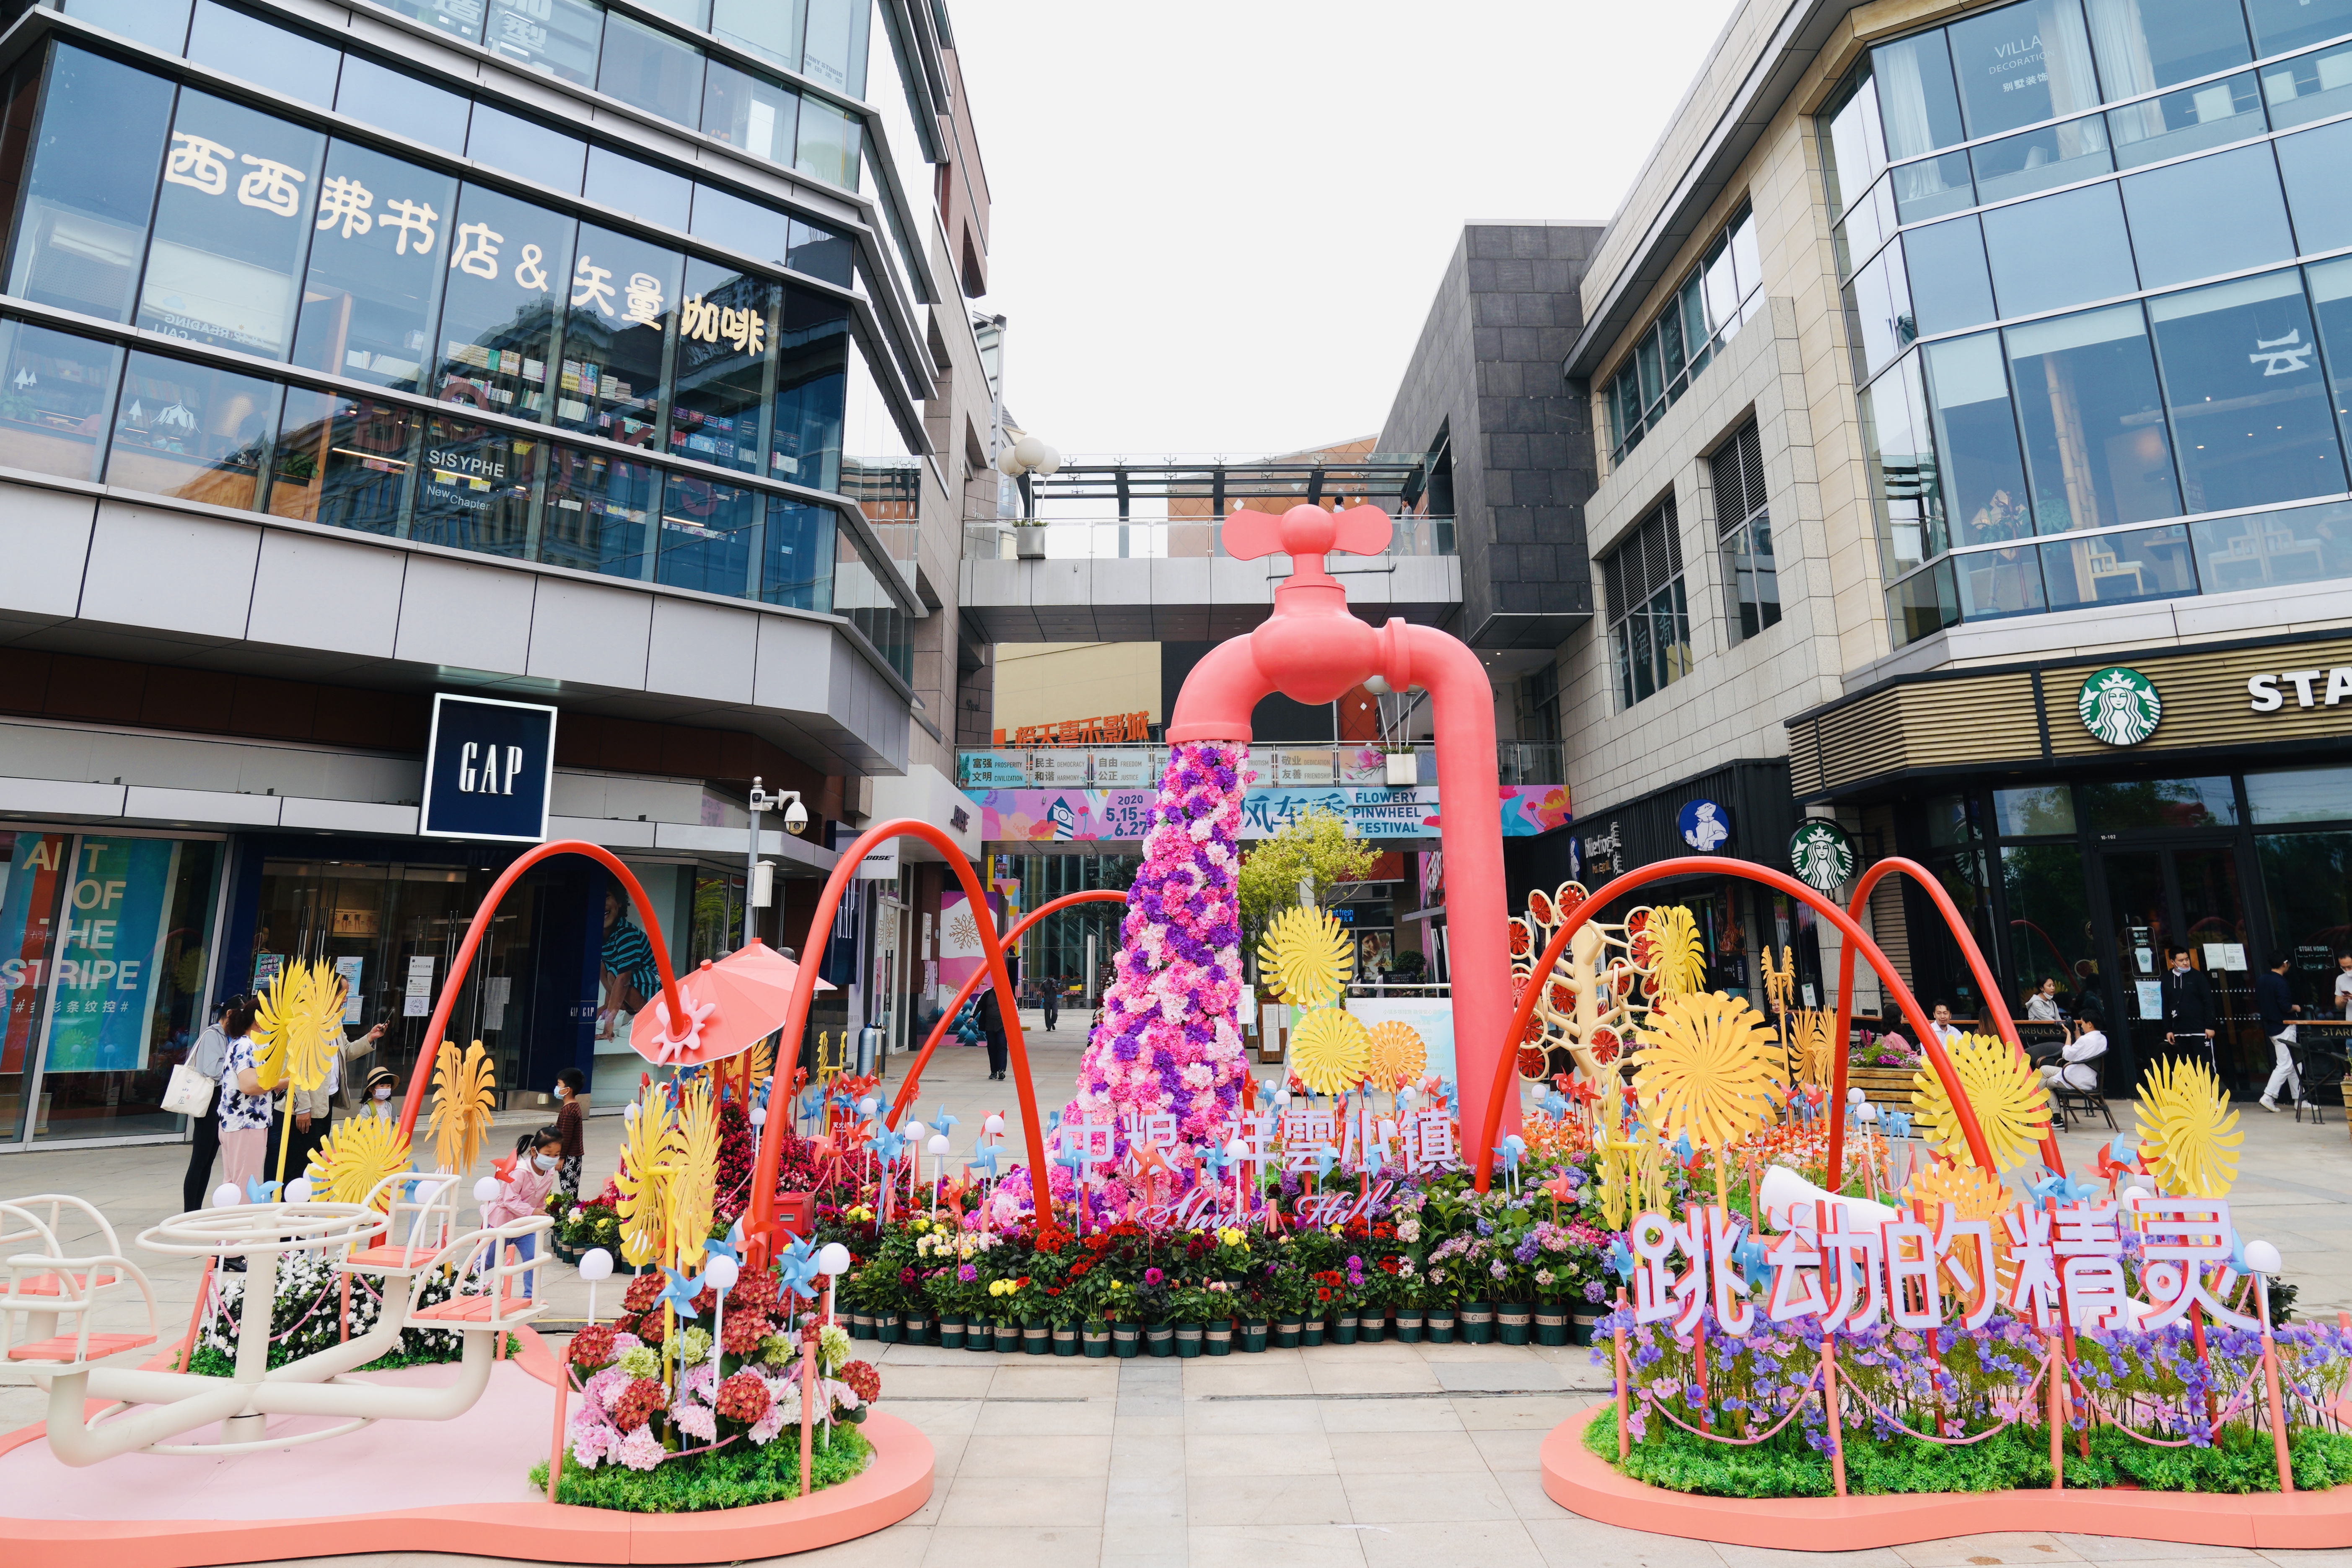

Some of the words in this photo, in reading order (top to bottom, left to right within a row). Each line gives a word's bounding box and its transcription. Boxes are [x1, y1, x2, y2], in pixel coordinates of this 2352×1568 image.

[1995, 35, 2043, 58] VILLA
[821, 62, 842, 78] STUDIO
[1989, 49, 2055, 75] DECORATION
[2003, 72, 2048, 92] 别墅装饰
[164, 131, 504, 280] 西西弗书店
[515, 244, 549, 292] &
[570, 255, 764, 357] 矢量咖啡
[2249, 328, 2312, 376] 云
[428, 450, 505, 478] SISYPHE
[427, 485, 451, 498] New
[450, 494, 490, 511] Chapter
[458, 741, 523, 795] GAP
[973, 758, 992, 768] 富强
[1035, 758, 1054, 768] 民主
[1098, 757, 1118, 767] 自由
[1282, 755, 1301, 765] 敬业
[972, 771, 992, 782] 文明
[1035, 771, 1055, 781] 和谐
[1098, 771, 1118, 780] 公正
[1282, 769, 1302, 779] 友善
[1118, 795, 1143, 805] 2020
[1355, 792, 1418, 803] FLOWERY
[950, 805, 970, 832] BOSE
[1353, 807, 1421, 818] PINWHEEL
[1115, 821, 1148, 837] 6.27
[1359, 822, 1419, 833] FESTIVAL
[73, 879, 127, 910] OF
[2, 958, 140, 990] STRIPE
[583, 1007, 594, 1017] GAP
[1631, 1197, 2261, 1338] 跳动的精灵
